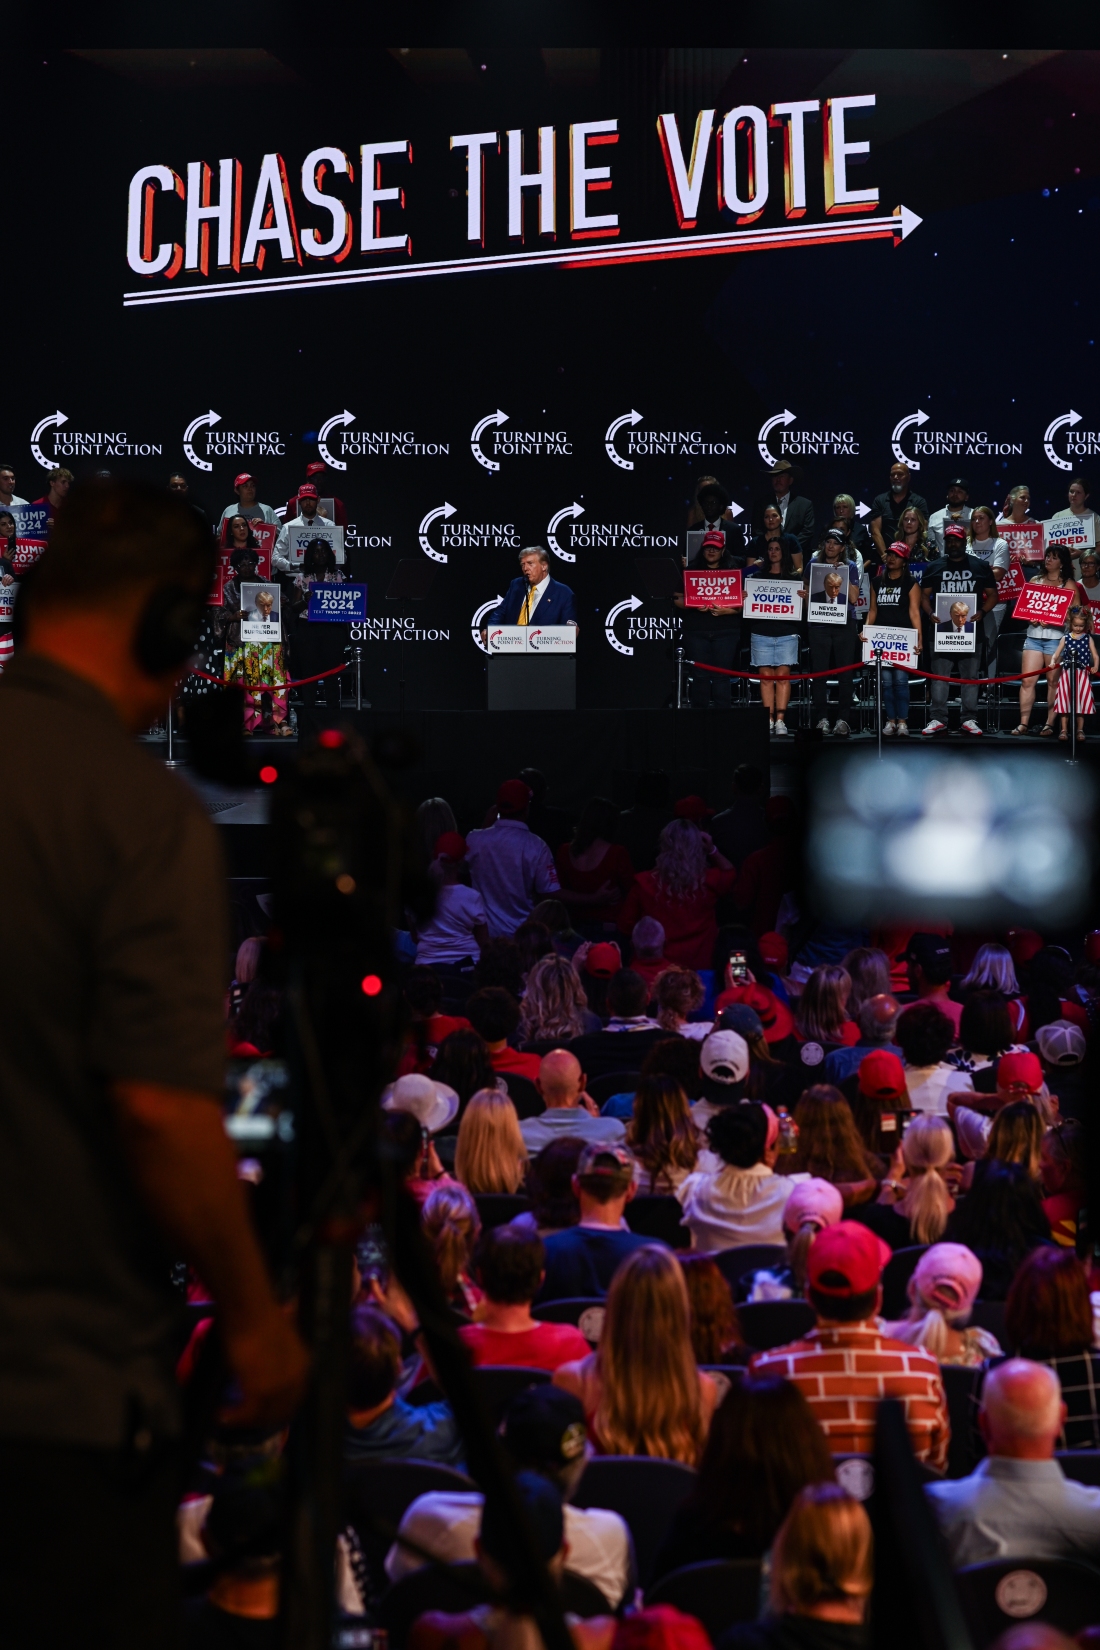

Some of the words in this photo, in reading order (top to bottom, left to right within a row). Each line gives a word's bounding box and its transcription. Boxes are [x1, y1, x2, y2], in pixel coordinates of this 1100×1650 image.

[127, 140, 411, 277] CHASE
[450, 119, 619, 244] THE
[658, 95, 879, 228] VOTE
[53, 432, 126, 443] TURNING
[205, 432, 279, 443] TURNING
[340, 432, 414, 443] TURNING
[493, 432, 566, 443] TURNING
[628, 432, 701, 443] TURNING
[780, 432, 853, 443] TURNING
[914, 432, 987, 443] TURNING
[54, 444, 102, 455] POINT
[106, 444, 161, 455] ACTION
[207, 444, 255, 455] POINT
[259, 444, 285, 455] PAC
[342, 444, 390, 455] POINT
[393, 444, 449, 455] ACTION
[494, 444, 542, 455] POINT
[547, 444, 572, 455] PAC
[629, 444, 677, 455] POINT
[680, 444, 736, 455] ACTION
[781, 444, 829, 455] POINT
[834, 444, 859, 455] PAC
[915, 444, 963, 455] POINT
[966, 444, 1022, 455] ACTION
[12, 511, 46, 521] RUMP
[16, 521, 41, 531] 024
[441, 524, 514, 535] TURNING
[569, 524, 643, 535] TURNING
[1050, 522, 1062, 530] JOE
[1049, 527, 1085, 539] YOU'RE
[296, 540, 334, 548] YOE
[345, 536, 391, 547] CTION
[442, 536, 490, 547] POINT
[495, 536, 520, 547] PAC
[570, 536, 618, 547] POINT
[622, 536, 678, 547] ACTION
[1009, 540, 1033, 549] 024
[1048, 535, 1088, 547] FIRED!
[9, 545, 45, 556] RUMP
[943, 570, 972, 580] DAD
[690, 577, 736, 587] TRUMP
[940, 581, 976, 593] ARMY
[996, 579, 1016, 590] 024
[315, 590, 361, 600] TRUMP
[697, 586, 730, 596] 2024
[753, 593, 792, 603] YOU'RE
[877, 594, 901, 603] ARMY
[1026, 590, 1067, 604] TRUMP
[321, 600, 354, 609] 2024
[752, 603, 794, 614] FIRED!
[1027, 600, 1057, 612] 2024
[352, 618, 414, 628] URNING
[627, 618, 683, 628] TURNI
[351, 629, 390, 640] OINT
[393, 629, 449, 640] ACTION
[629, 629, 677, 640] POINT
[871, 640, 908, 651] YOU'RE
[870, 650, 910, 662] FRED!
